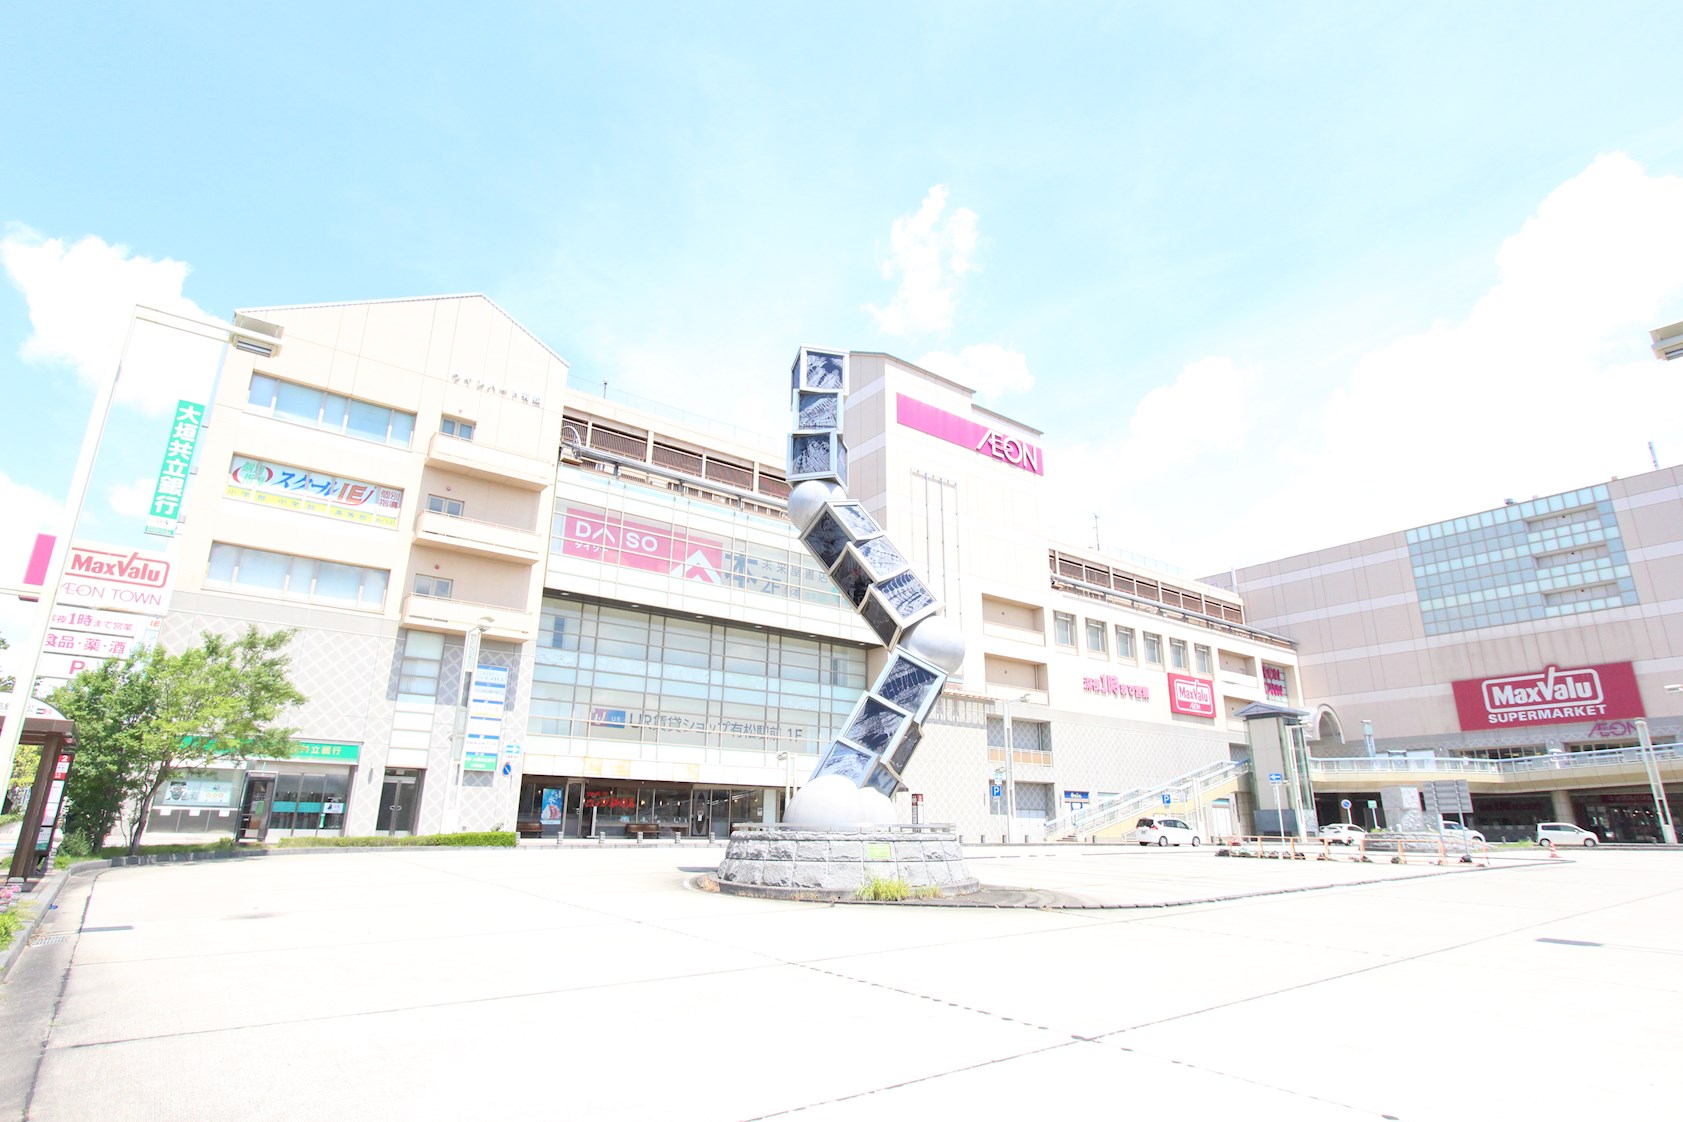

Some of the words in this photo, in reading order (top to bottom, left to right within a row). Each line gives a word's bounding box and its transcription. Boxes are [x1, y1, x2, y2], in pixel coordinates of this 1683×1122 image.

[154, 404, 201, 516] 大垣共立銀行
[575, 520, 658, 552] DASO
[71, 552, 161, 582] MaxValu
[725, 551, 758, 589] 本
[761, 560, 828, 584] 未来屋書店
[111, 588, 161, 606] TOWN
[760, 575, 781, 595] 2F
[1179, 679, 1208, 703] MaxValu
[1491, 667, 1593, 706] MaxValu
[1488, 704, 1607, 724] SUPERMARKET
[787, 728, 803, 743] 1F
[993, 786, 1001, 796] P
